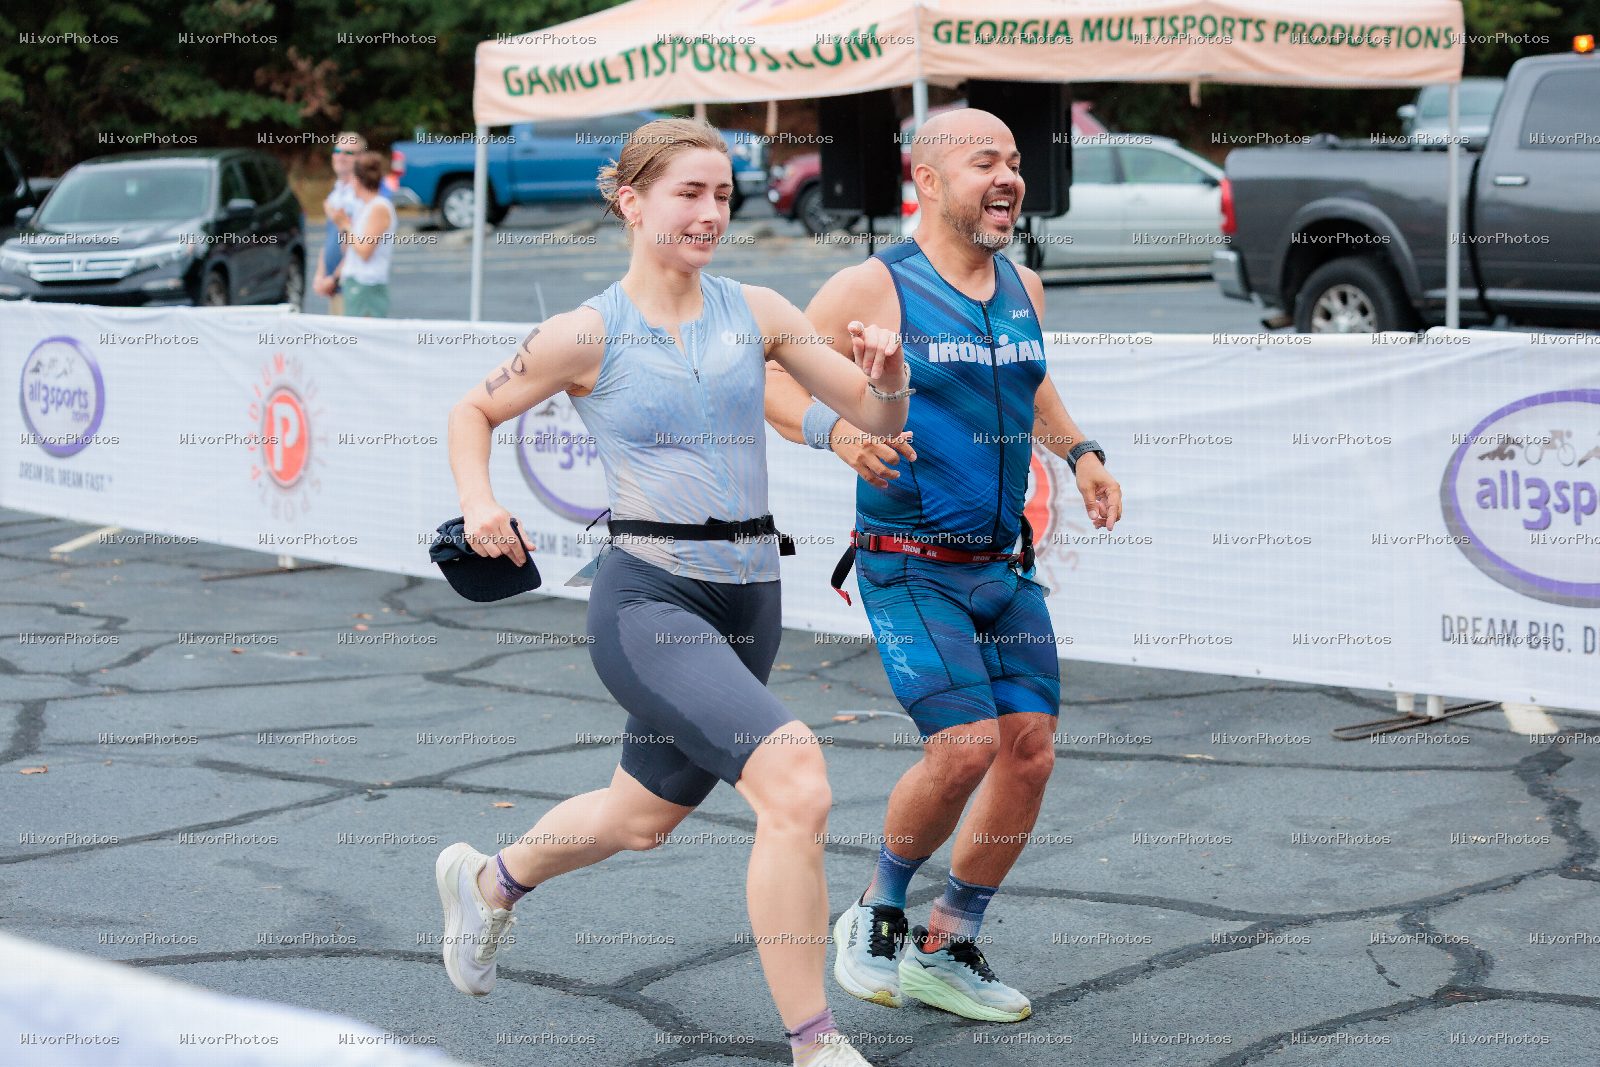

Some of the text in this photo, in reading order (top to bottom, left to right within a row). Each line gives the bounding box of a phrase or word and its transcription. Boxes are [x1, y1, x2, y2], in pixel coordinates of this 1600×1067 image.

[933, 14, 1454, 49] GEORGIA MULTISPORTS PRODUCTIONS
[28, 379, 89, 416] all3sports
[1441, 613, 1600, 655] DREAM BIG. D
